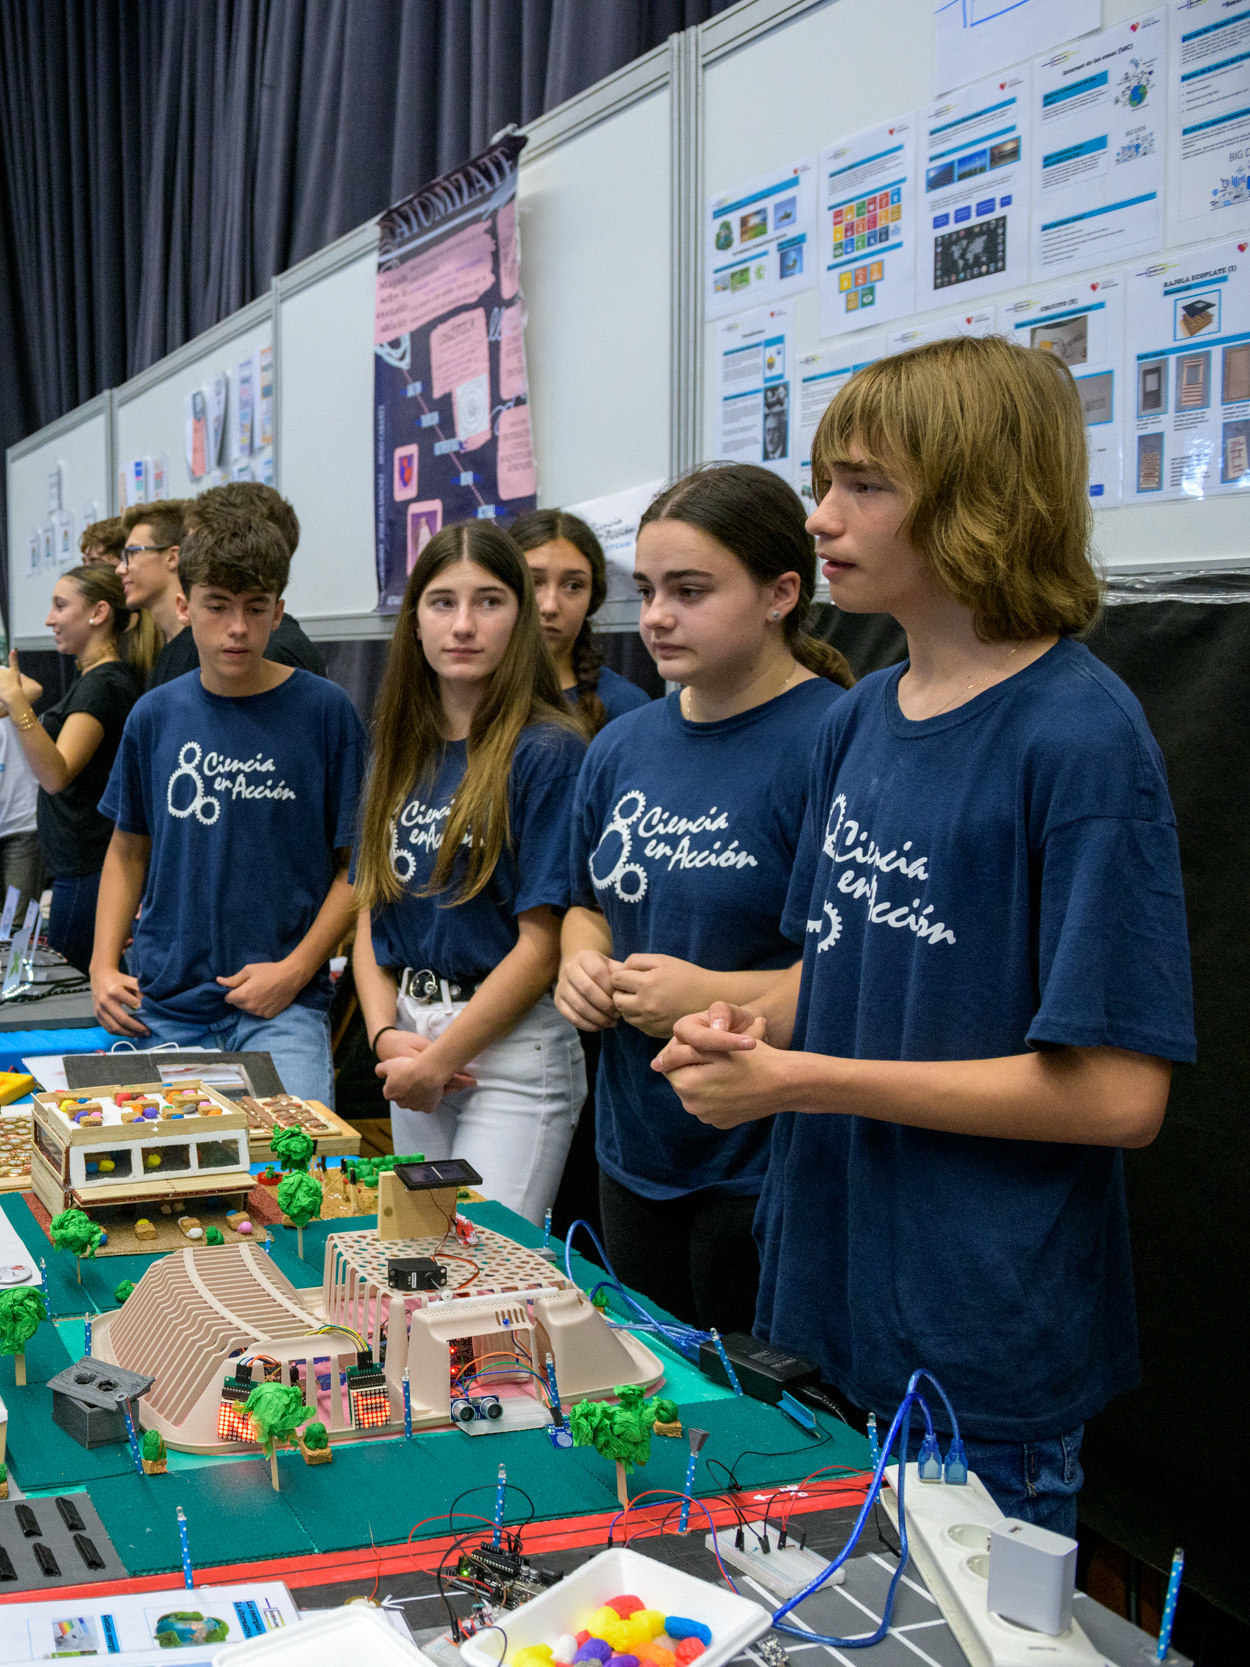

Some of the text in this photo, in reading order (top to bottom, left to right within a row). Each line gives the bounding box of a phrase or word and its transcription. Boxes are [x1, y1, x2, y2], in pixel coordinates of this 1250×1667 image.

[1229, 150, 1244, 162] BIG
[1191, 266, 1228, 282] ECOPLATE
[203, 752, 276, 777] Ciencia
[214, 773, 297, 800] en Acción
[401, 798, 456, 827] Cienci
[638, 806, 729, 838] Ciencia
[644, 835, 759, 871] en Acción
[837, 870, 871, 899] en
[245, 1600, 254, 1609] Las
[102, 1614, 113, 1633] Gestión
